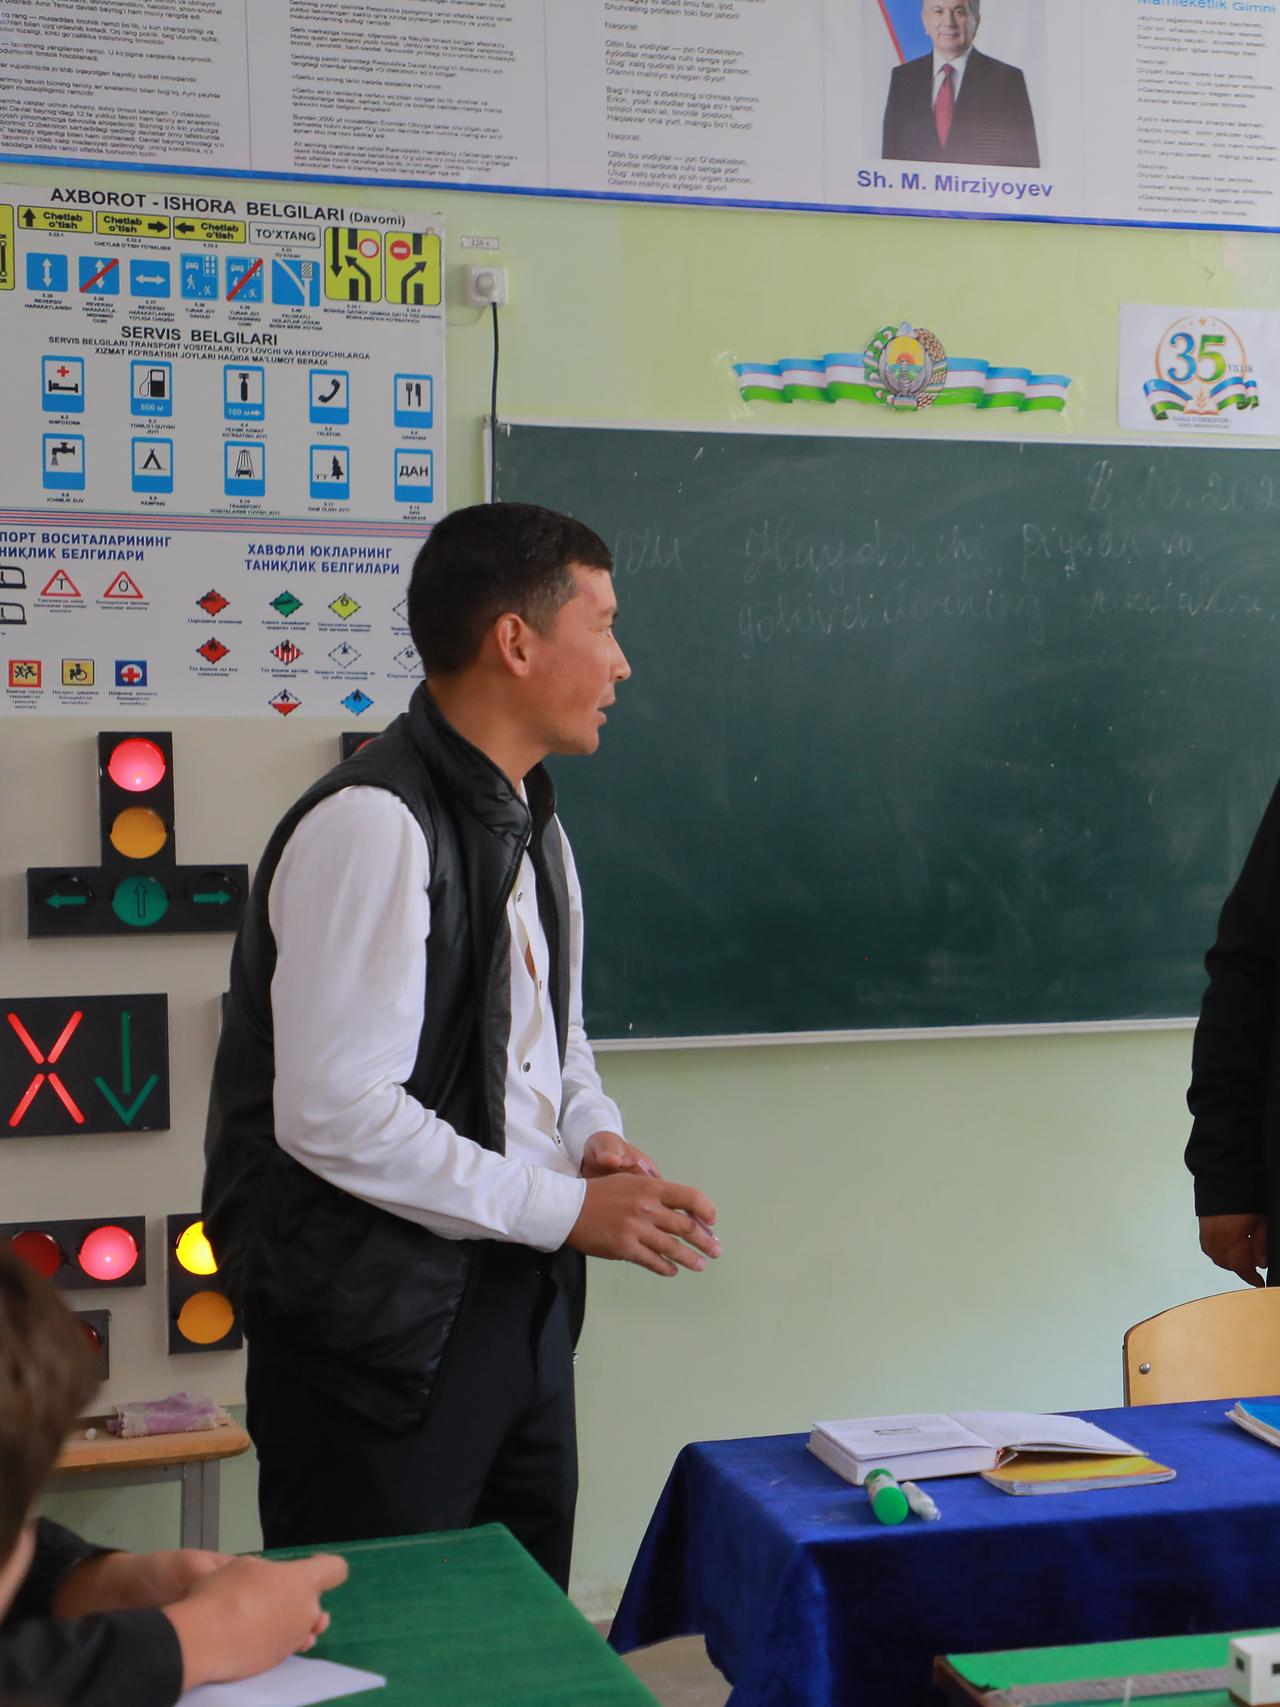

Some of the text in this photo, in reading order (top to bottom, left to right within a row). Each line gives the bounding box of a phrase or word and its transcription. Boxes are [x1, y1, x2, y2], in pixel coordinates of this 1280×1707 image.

[1232, 2, 1276, 13] Gimni
[857, 170, 1053, 202] Sh. M. Mirziyoyev
[51, 188, 406, 227] AXBOROT ISHORA BELGILARI (Davomi)
[43, 210, 84, 224] Chetlab
[103, 215, 143, 228] Chetlab
[201, 221, 240, 234] Chetlab
[121, 324, 279, 347] SERVIS BELGILARI
[48, 336, 80, 346] SERVIS
[81, 337, 128, 349] BELGILARI
[128, 340, 181, 351] TRANSPORT
[282, 347, 294, 356] VA
[94, 348, 125, 358] XIZMAT
[1168, 332, 1227, 383] 35
[400, 465, 429, 478] ДАН
[42, 533, 172, 548] ВОСИТАЛАРИНИНГ
[61, 547, 145, 562] БЕЛГИЛАРИ
[248, 544, 392, 559] ХАВФЛИ ЮКЛАРНИНГ
[245, 560, 400, 575] ТАНИҚЛИК БЕЛГИЛАРИ
